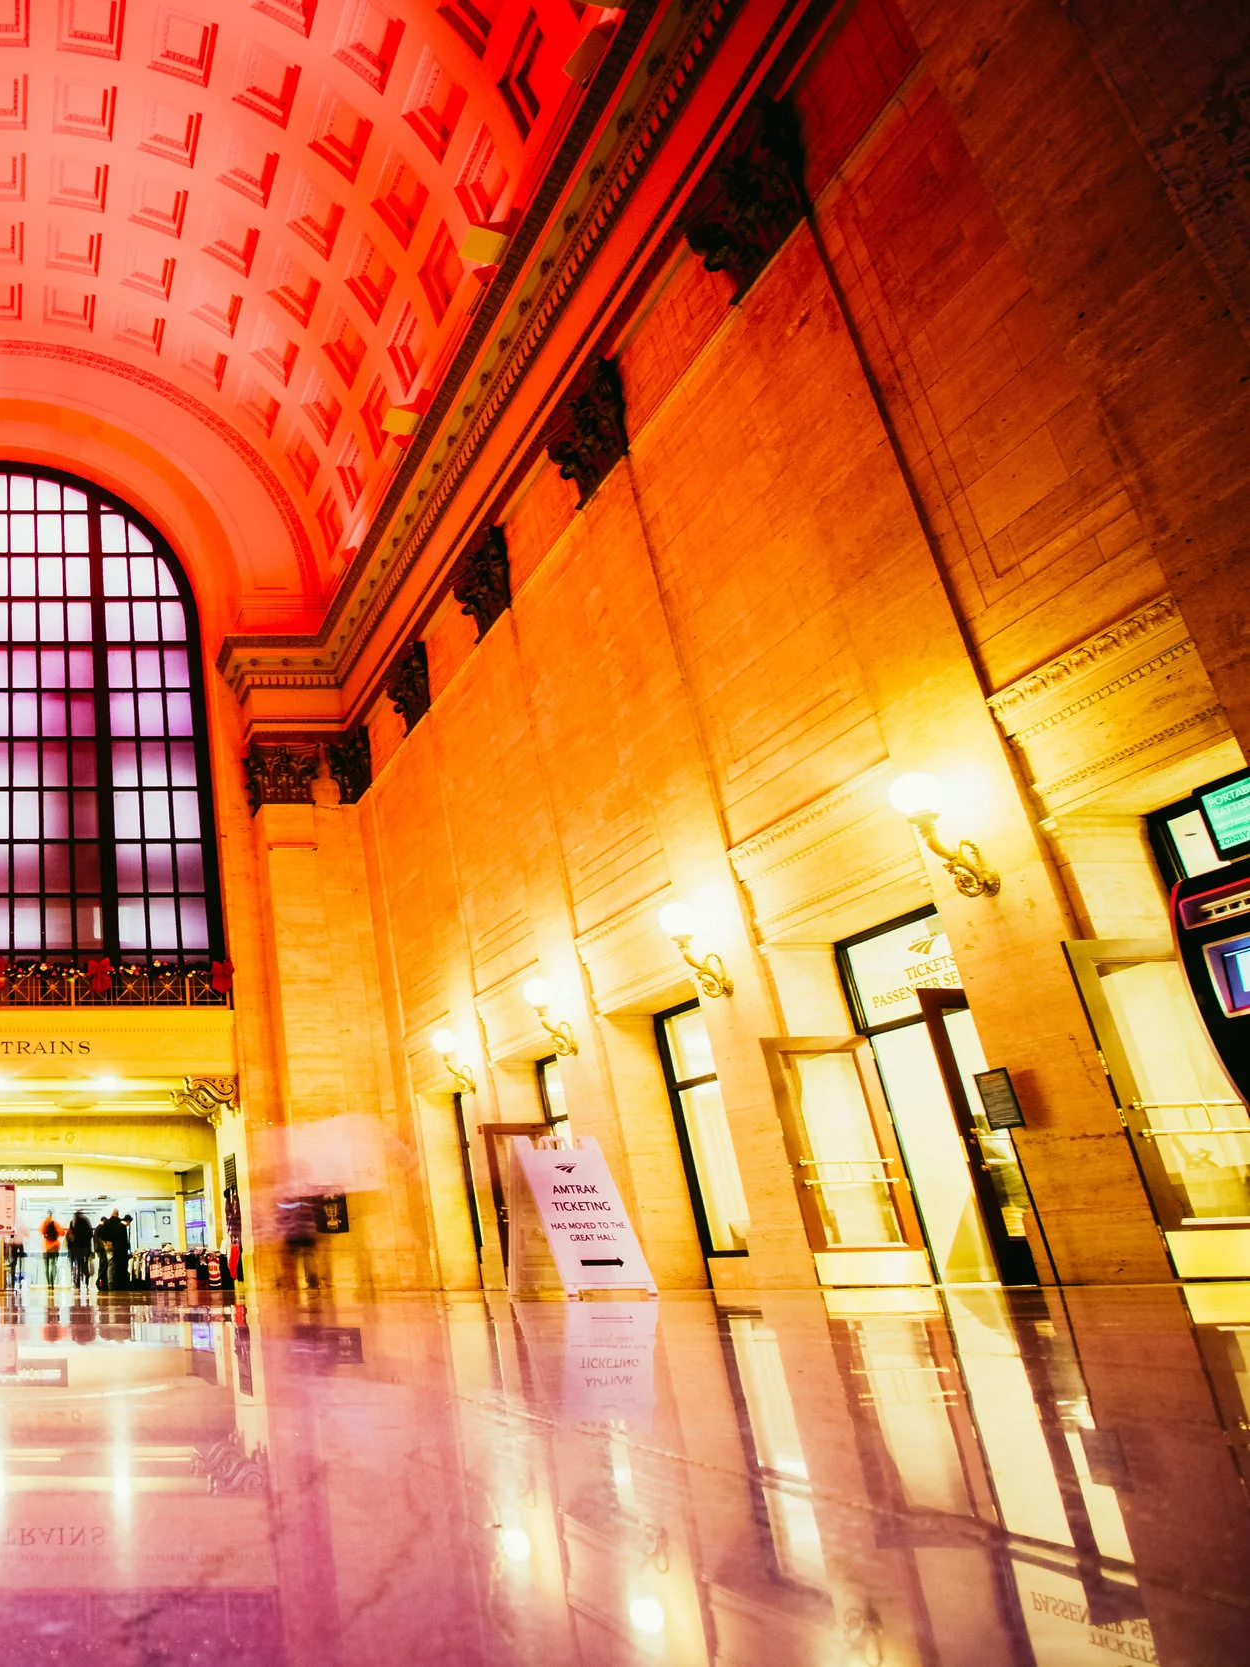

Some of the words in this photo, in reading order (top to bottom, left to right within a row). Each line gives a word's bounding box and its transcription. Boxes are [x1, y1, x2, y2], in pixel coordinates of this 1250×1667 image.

[1208, 784, 1250, 808] PORTAB
[1223, 830, 1249, 845] ONLY
[903, 952, 957, 980] TICKETS
[0, 1040, 91, 1055] TRAINS
[552, 1184, 600, 1195] AMTRAK
[551, 1201, 612, 1212] TICKETING
[550, 1222, 568, 1230] HAS
[568, 1221, 597, 1230] MOVED
[597, 1221, 610, 1229] TO
[610, 1221, 627, 1229] THE
[569, 1233, 595, 1242] GREAT
[596, 1233, 618, 1241] HALL
